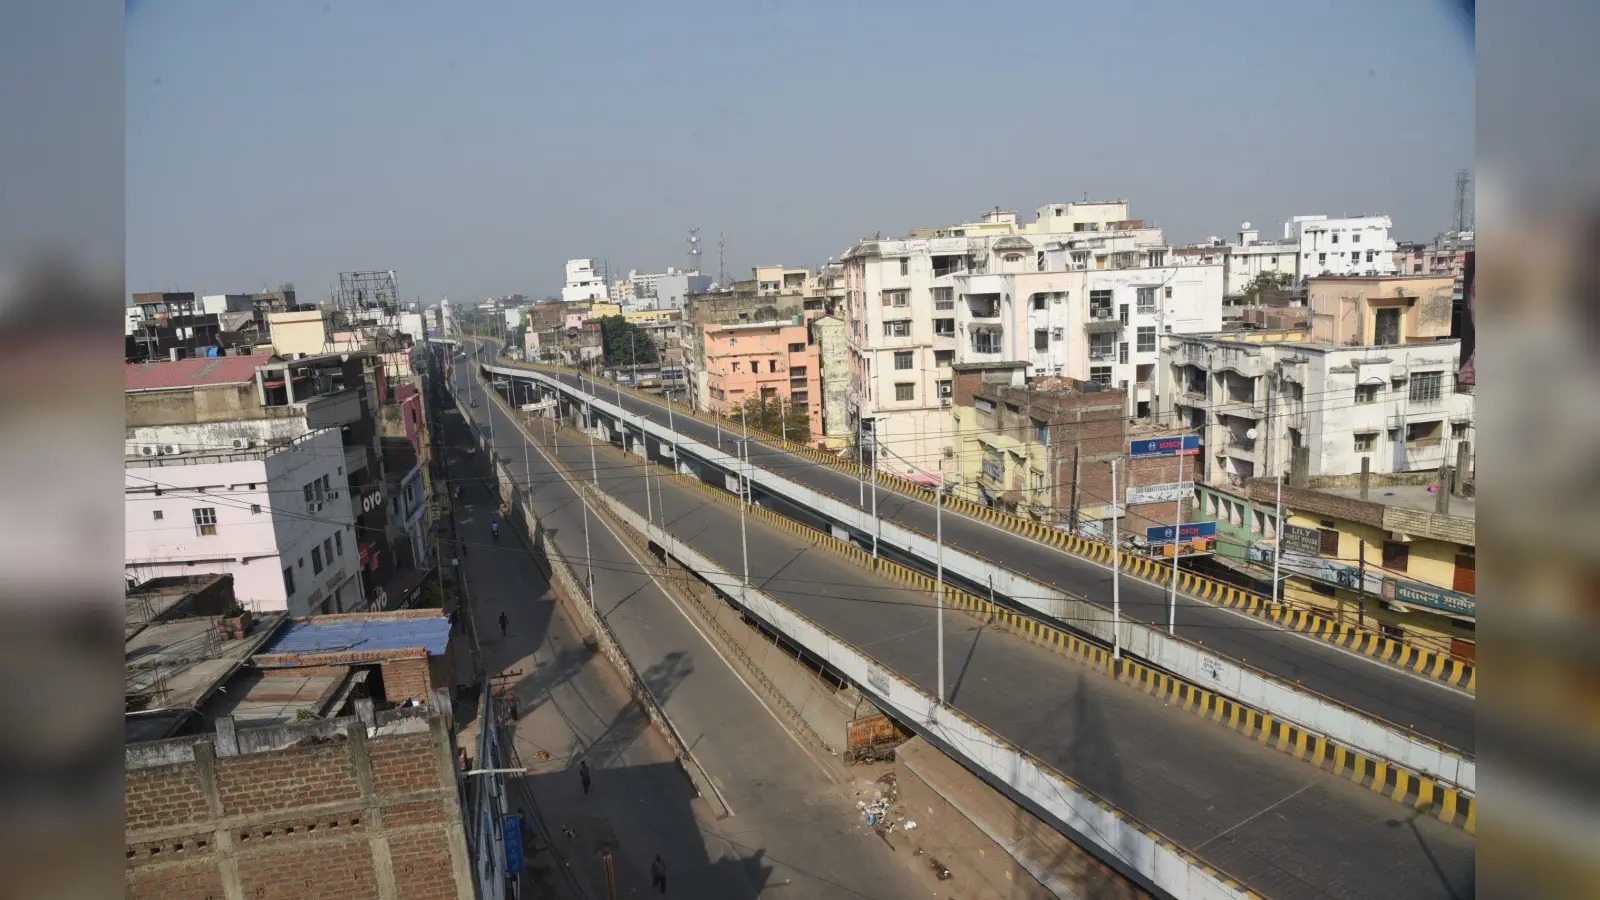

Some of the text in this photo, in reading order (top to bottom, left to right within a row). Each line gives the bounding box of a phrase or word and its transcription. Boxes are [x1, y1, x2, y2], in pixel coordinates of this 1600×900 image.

[363, 491, 381, 512] OYO
[1284, 532, 1318, 545] GUEST HOUSE
[1291, 527, 1310, 536] LILY
[371, 591, 388, 612] OYO
